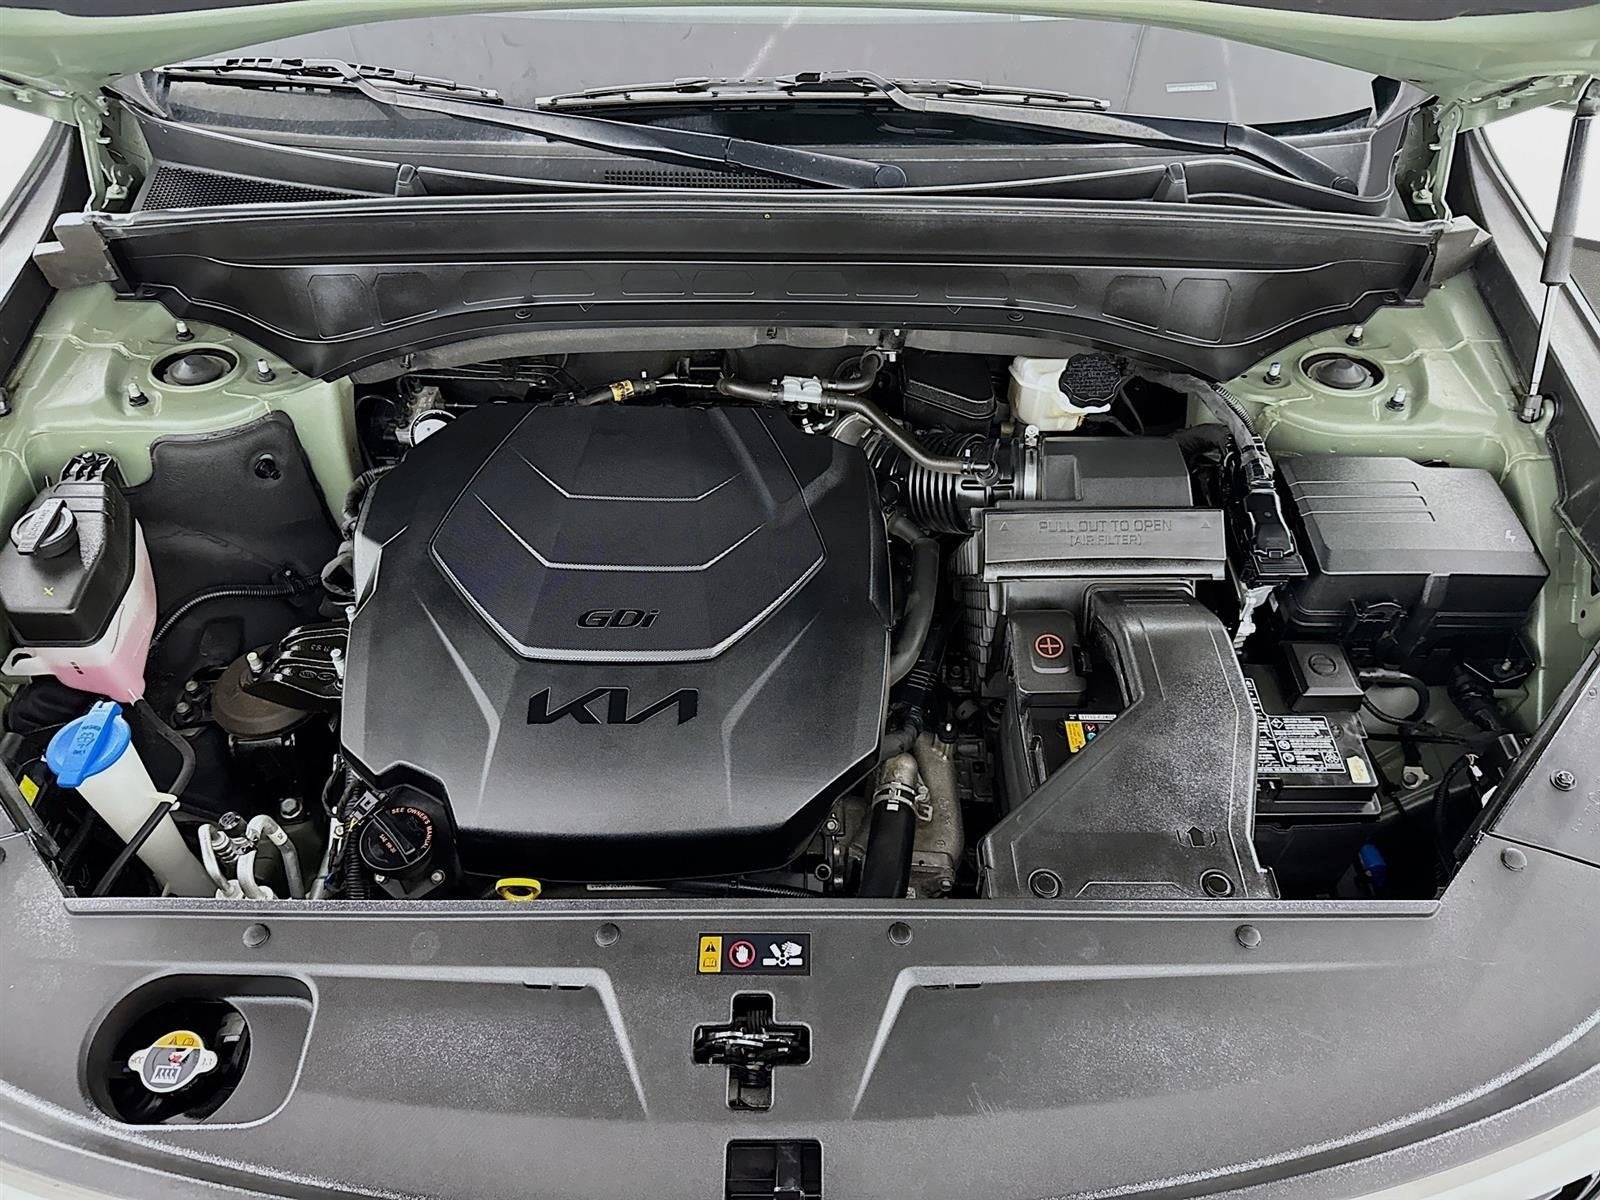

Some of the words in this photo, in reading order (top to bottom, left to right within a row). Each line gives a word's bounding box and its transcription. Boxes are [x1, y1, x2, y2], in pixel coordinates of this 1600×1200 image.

[1038, 521, 1074, 533] PULL
[1078, 520, 1107, 533] OUT
[1110, 520, 1130, 532] TO
[1133, 519, 1172, 532] OPEN
[576, 608, 661, 629] GDi
[527, 686, 699, 725] KIA
[391, 807, 405, 815] SEE
[406, 807, 431, 825] OWNER'S
[420, 825, 433, 849] MANUAL
